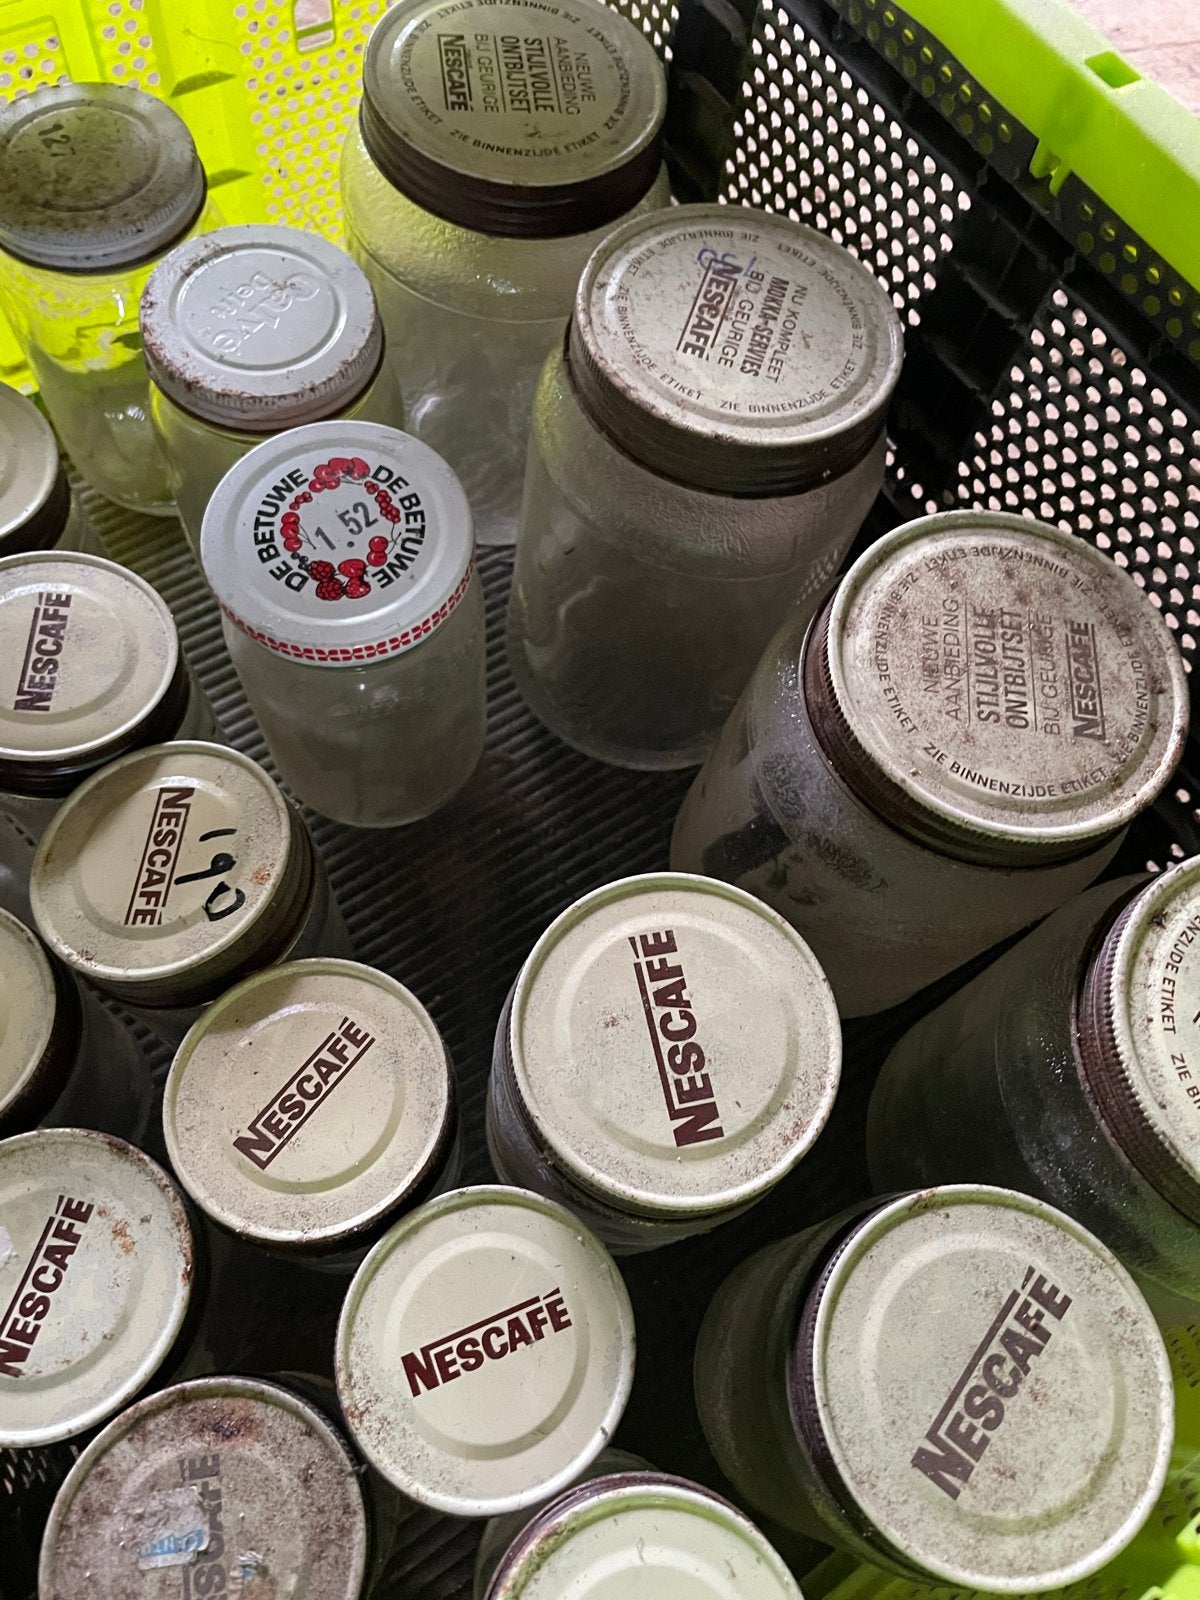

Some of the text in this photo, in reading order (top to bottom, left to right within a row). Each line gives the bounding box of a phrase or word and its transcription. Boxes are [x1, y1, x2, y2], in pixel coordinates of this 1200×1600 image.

[477, 56, 499, 113] GEURIGE
[500, 35, 532, 114] ONTBIJTSET
[524, 38, 555, 113] STIJLVOLLE
[554, 37, 581, 116] AANBIEDING
[574, 51, 596, 102] NIEUWE
[718, 299, 754, 368] GEURIGE
[740, 276, 790, 378] MOKKA-SERVIES
[765, 284, 808, 383] NU KOMPLEET
[660, 373, 703, 400] ETIKET
[720, 359, 857, 413] ZIE BINNENZIJDE ETIKET
[254, 468, 310, 593] DE BETUWE
[371, 464, 426, 589] DE BETUWE
[922, 615, 940, 694] NIEUWE
[942, 597, 962, 722] AANBIEDING
[972, 606, 1000, 725] STIJLVOLLE
[999, 607, 1029, 730] ONTBIJTSET
[1036, 613, 1061, 736] BIJ GEURIGE
[883, 687, 918, 734] ETIKET
[923, 742, 1107, 797] ZIE BINNENZIJDE ETIKET
[628, 929, 725, 1148] NESCAFÉ
[1161, 976, 1176, 1035] ETIKET
[232, 1016, 376, 1171] NESCAFÉ
[1171, 1053, 1192, 1082] ZIE
[400, 1286, 573, 1398] NESCAFÉ
[910, 1265, 1073, 1501] NESCAFÉ
